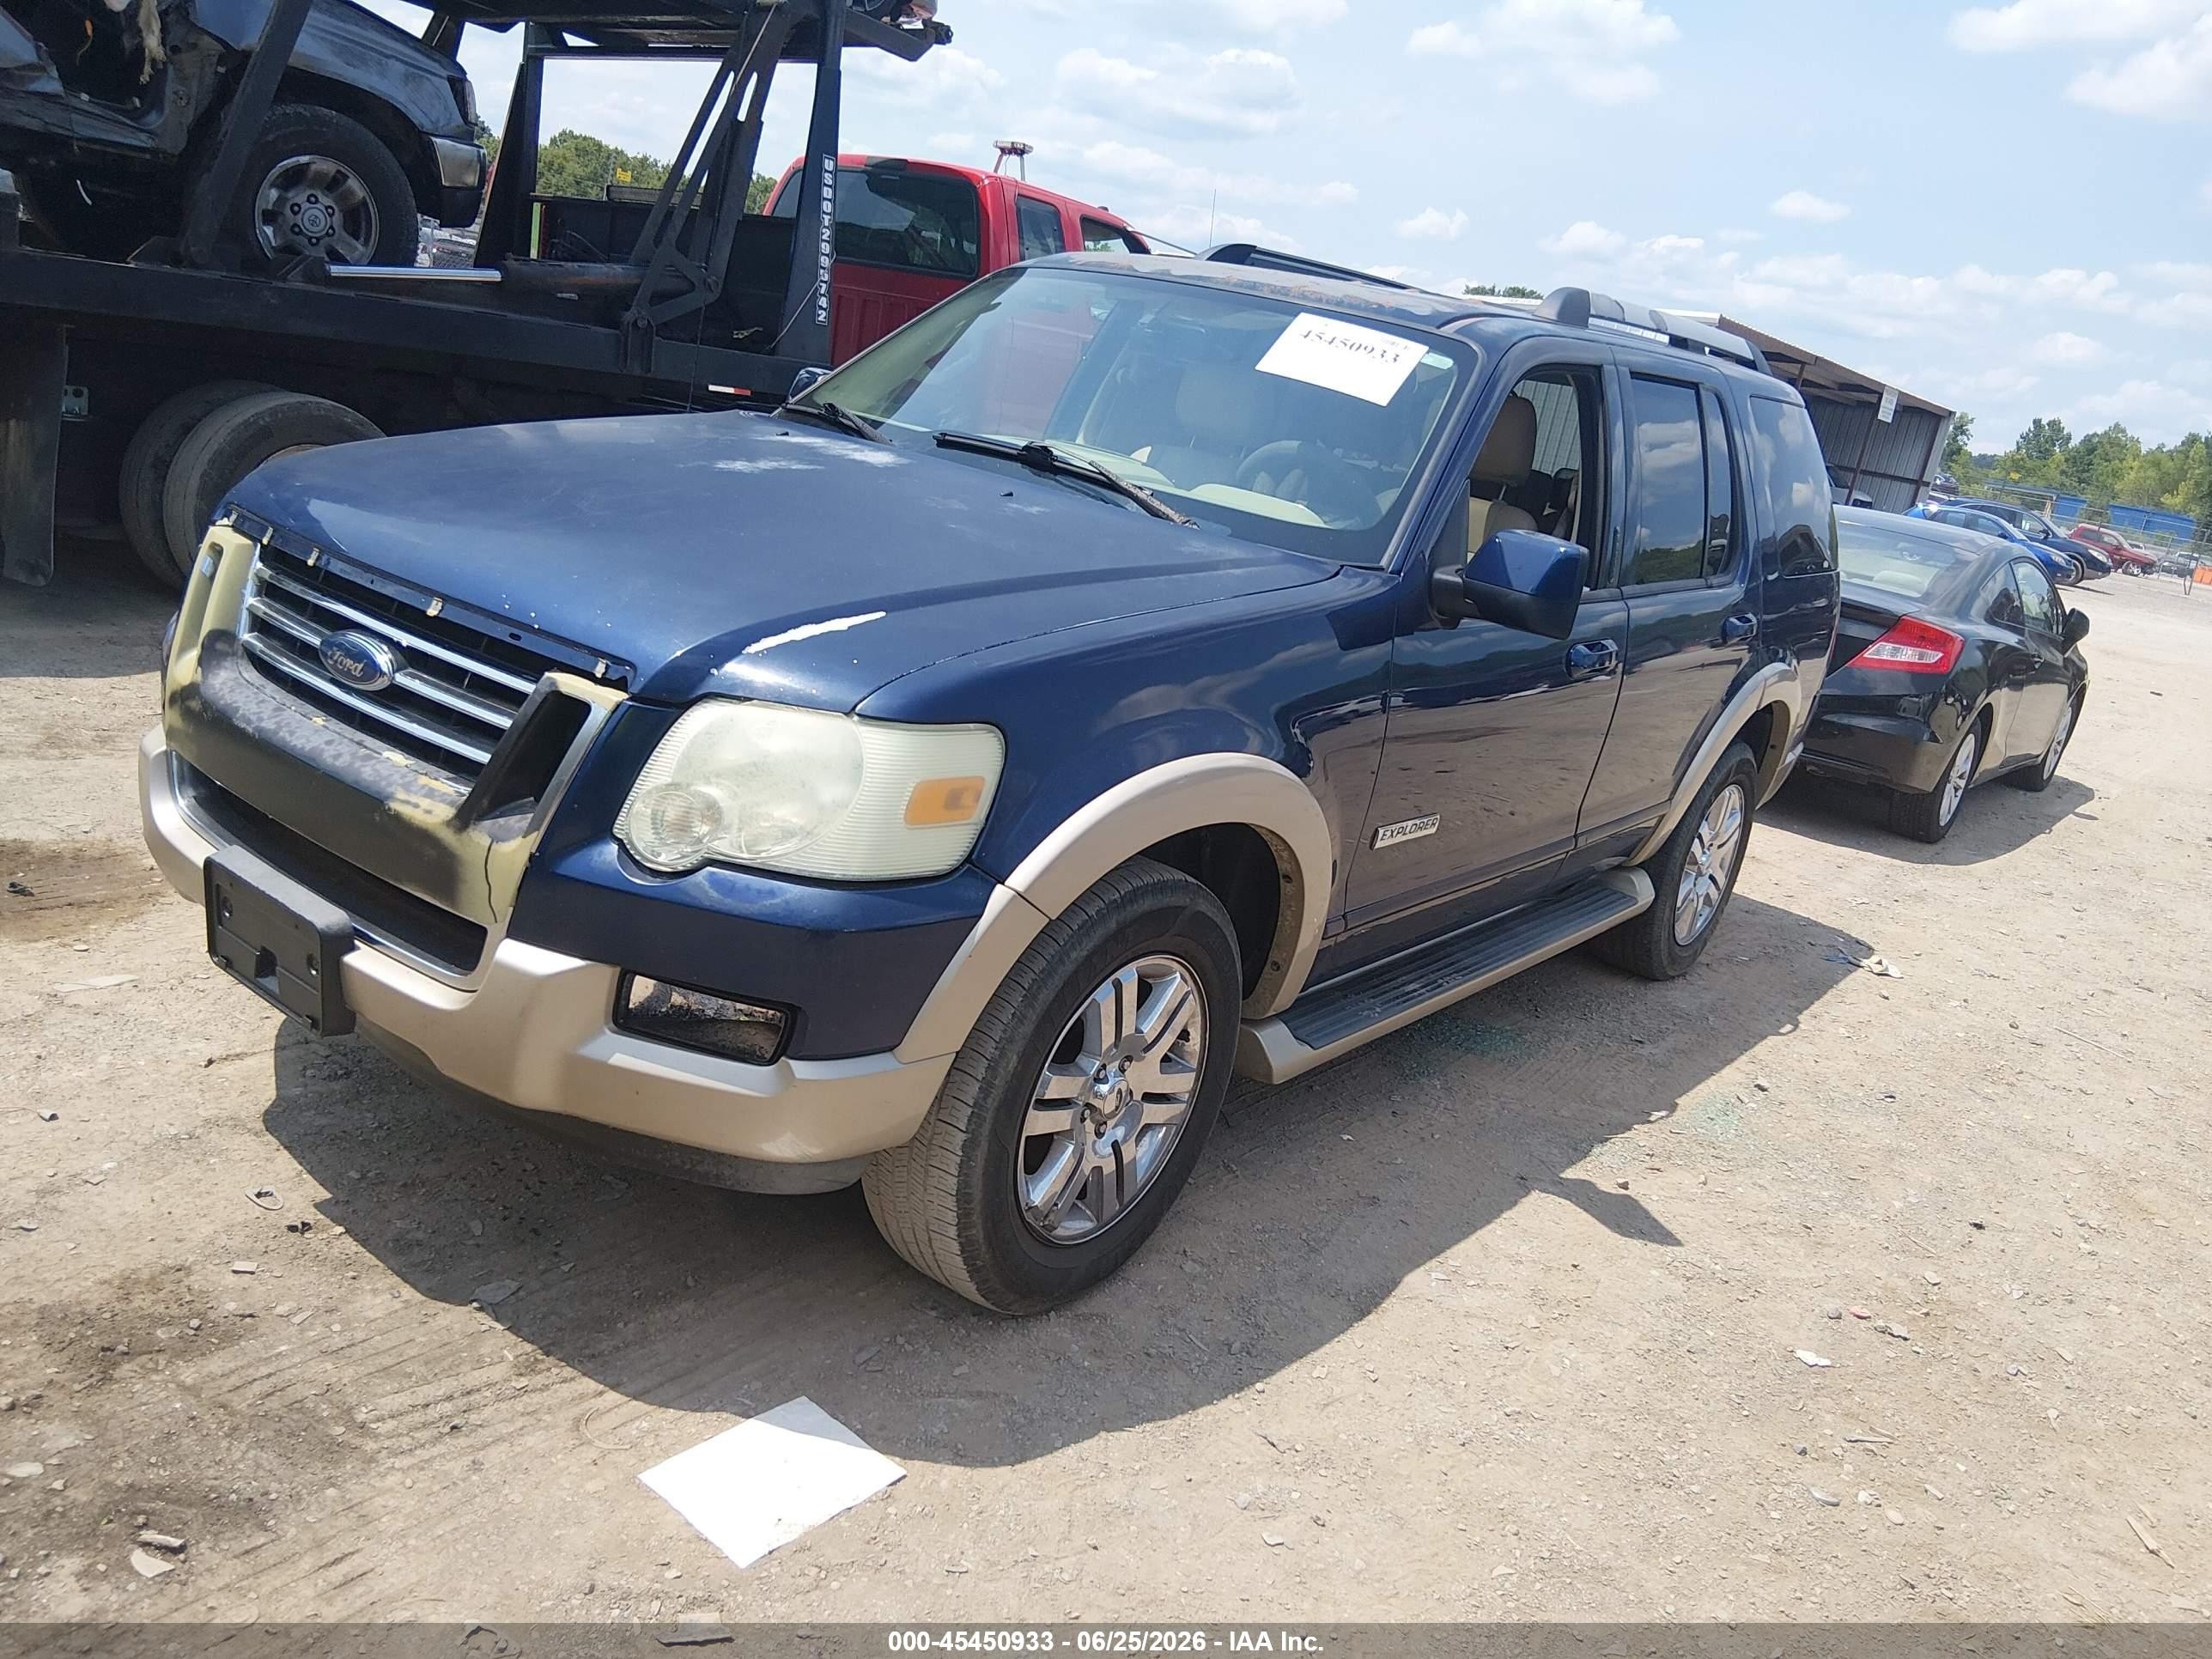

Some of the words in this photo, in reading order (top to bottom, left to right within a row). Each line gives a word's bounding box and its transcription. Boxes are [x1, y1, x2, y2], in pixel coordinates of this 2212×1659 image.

[1299, 329, 1401, 365] 45450933
[327, 641, 364, 678] Ford
[1379, 817, 1439, 842] EXPLORER
